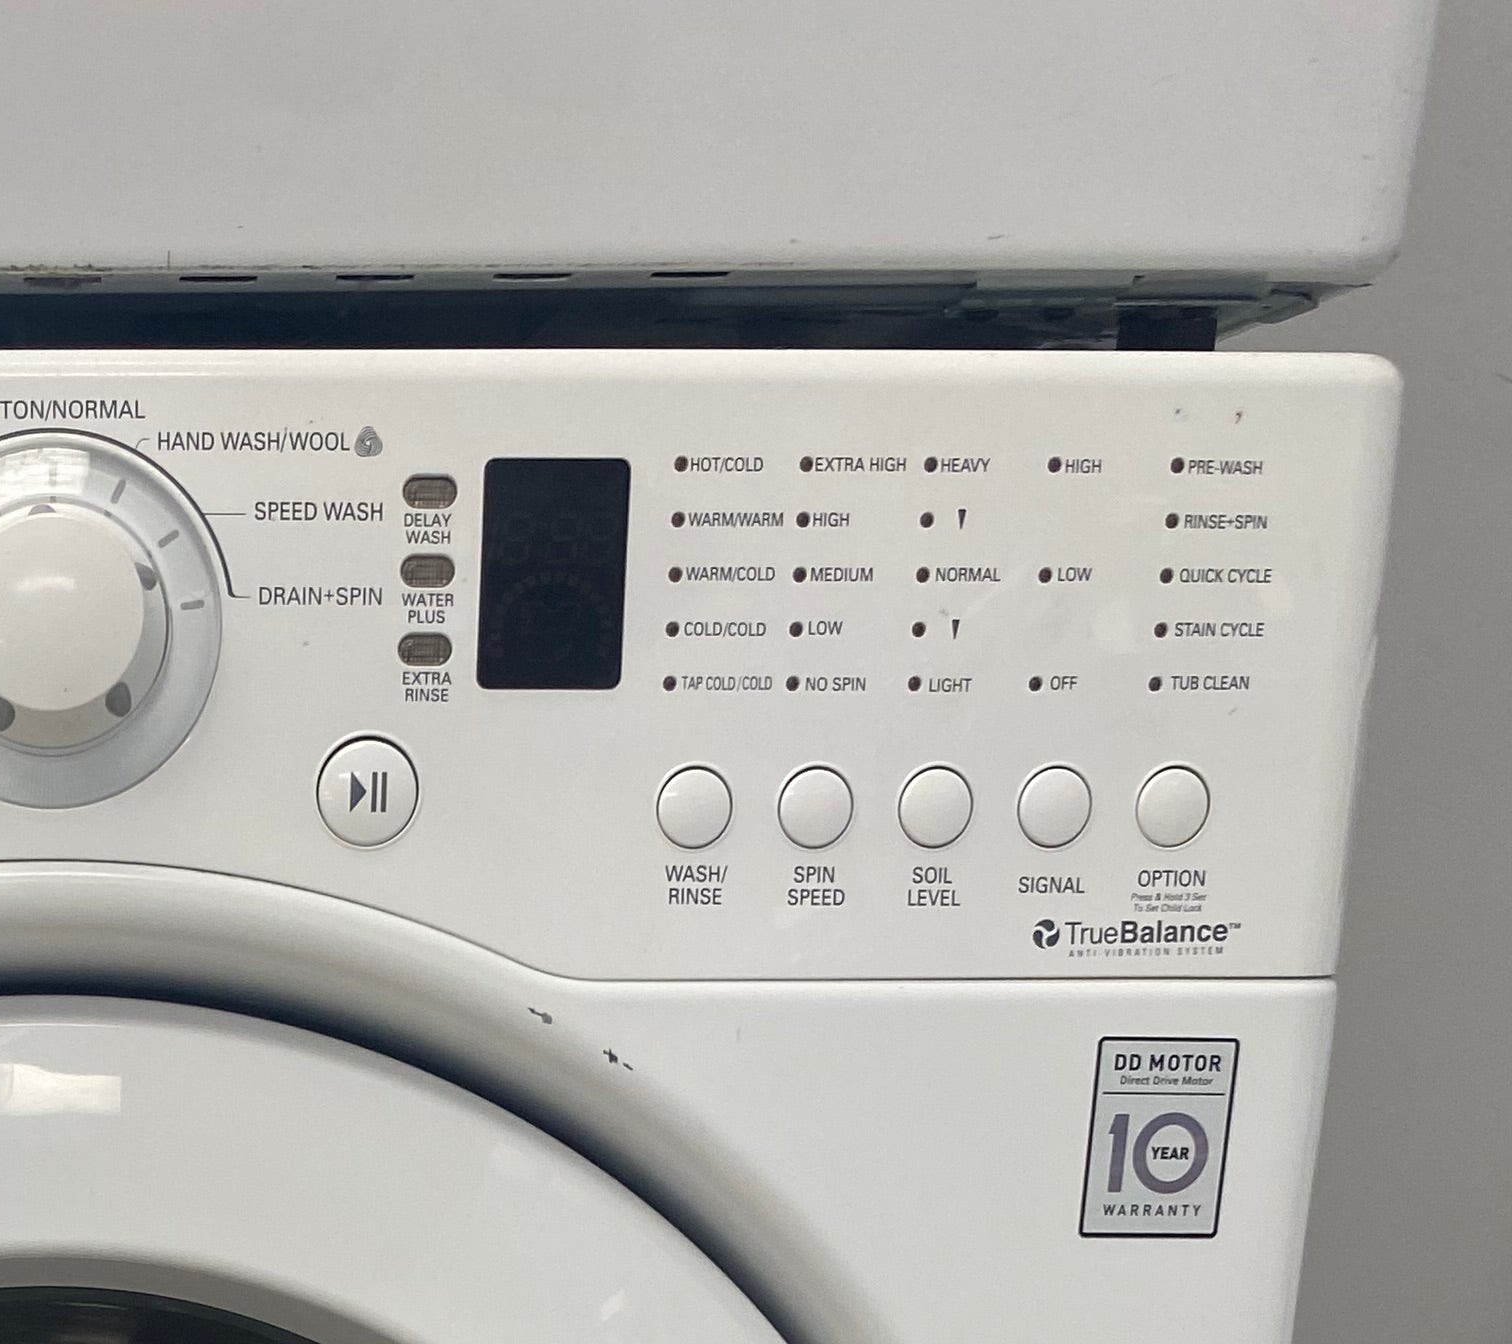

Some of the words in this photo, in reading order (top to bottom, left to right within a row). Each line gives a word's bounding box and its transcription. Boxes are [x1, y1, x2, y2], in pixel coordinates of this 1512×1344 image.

[157, 431, 215, 451] HAND
[220, 431, 351, 453] WASH/WOOL
[690, 456, 764, 474] HOT/COLD
[814, 456, 865, 472] EXTRA
[869, 456, 907, 473] HIGH
[940, 457, 991, 473] HEAVY
[1064, 458, 1102, 474] HIGH
[1187, 459, 1264, 476] PRE-WASH
[254, 501, 318, 521] SPEED
[323, 501, 384, 522] WASH
[403, 512, 453, 528] DELAY
[687, 511, 784, 528] WARM/WARM
[812, 511, 850, 528] HIGH
[1183, 514, 1268, 530] RINSE+SPIN
[405, 530, 451, 545] WASH
[685, 566, 776, 583] WARM/COLD
[810, 566, 874, 583] MEDIUM
[935, 566, 1001, 583] NORMAL
[1057, 566, 1093, 582] LOW
[1179, 567, 1225, 584] QUICK
[1227, 568, 1273, 584] CYCLE
[258, 586, 383, 606] DRAIN+SPIN
[401, 592, 454, 608] WATER
[407, 609, 446, 624] PLUS
[683, 621, 767, 638] COLD/COLD
[808, 620, 844, 636] LOW
[1174, 622, 1217, 638] STAIN
[1220, 622, 1265, 638] CYCLE
[402, 671, 453, 686] EXTRA
[681, 675, 704, 691] TAP
[705, 675, 773, 692] COLD/COLD
[805, 676, 829, 692] NO
[831, 676, 867, 692] SPIN
[928, 677, 973, 693] LIGHT
[1049, 675, 1078, 691] OFF
[1170, 675, 1200, 691] TUB
[1202, 675, 1250, 691] CLEAN
[404, 687, 449, 703] RINSE
[664, 864, 728, 884] WASH/
[793, 865, 836, 884] SPIN
[912, 866, 953, 885] SOIL
[1137, 869, 1206, 888] OPTION
[1018, 875, 1086, 894] SIGNAL
[668, 887, 723, 906] RINSE
[787, 888, 846, 907] SPEED
[907, 888, 961, 907] LEVEL
[1177, 945, 1224, 956] SYSTEM
[1114, 1053, 1142, 1072] DD
[1148, 1054, 1222, 1073] MOTOR
[1119, 1074, 1151, 1086] Direct
[1152, 1075, 1180, 1086] Drive
[1181, 1075, 1214, 1086] Motor
[1106, 1111, 1210, 1195] 10
[1150, 1146, 1191, 1161] YEAR
[1103, 1203, 1202, 1217] WARRANTY
